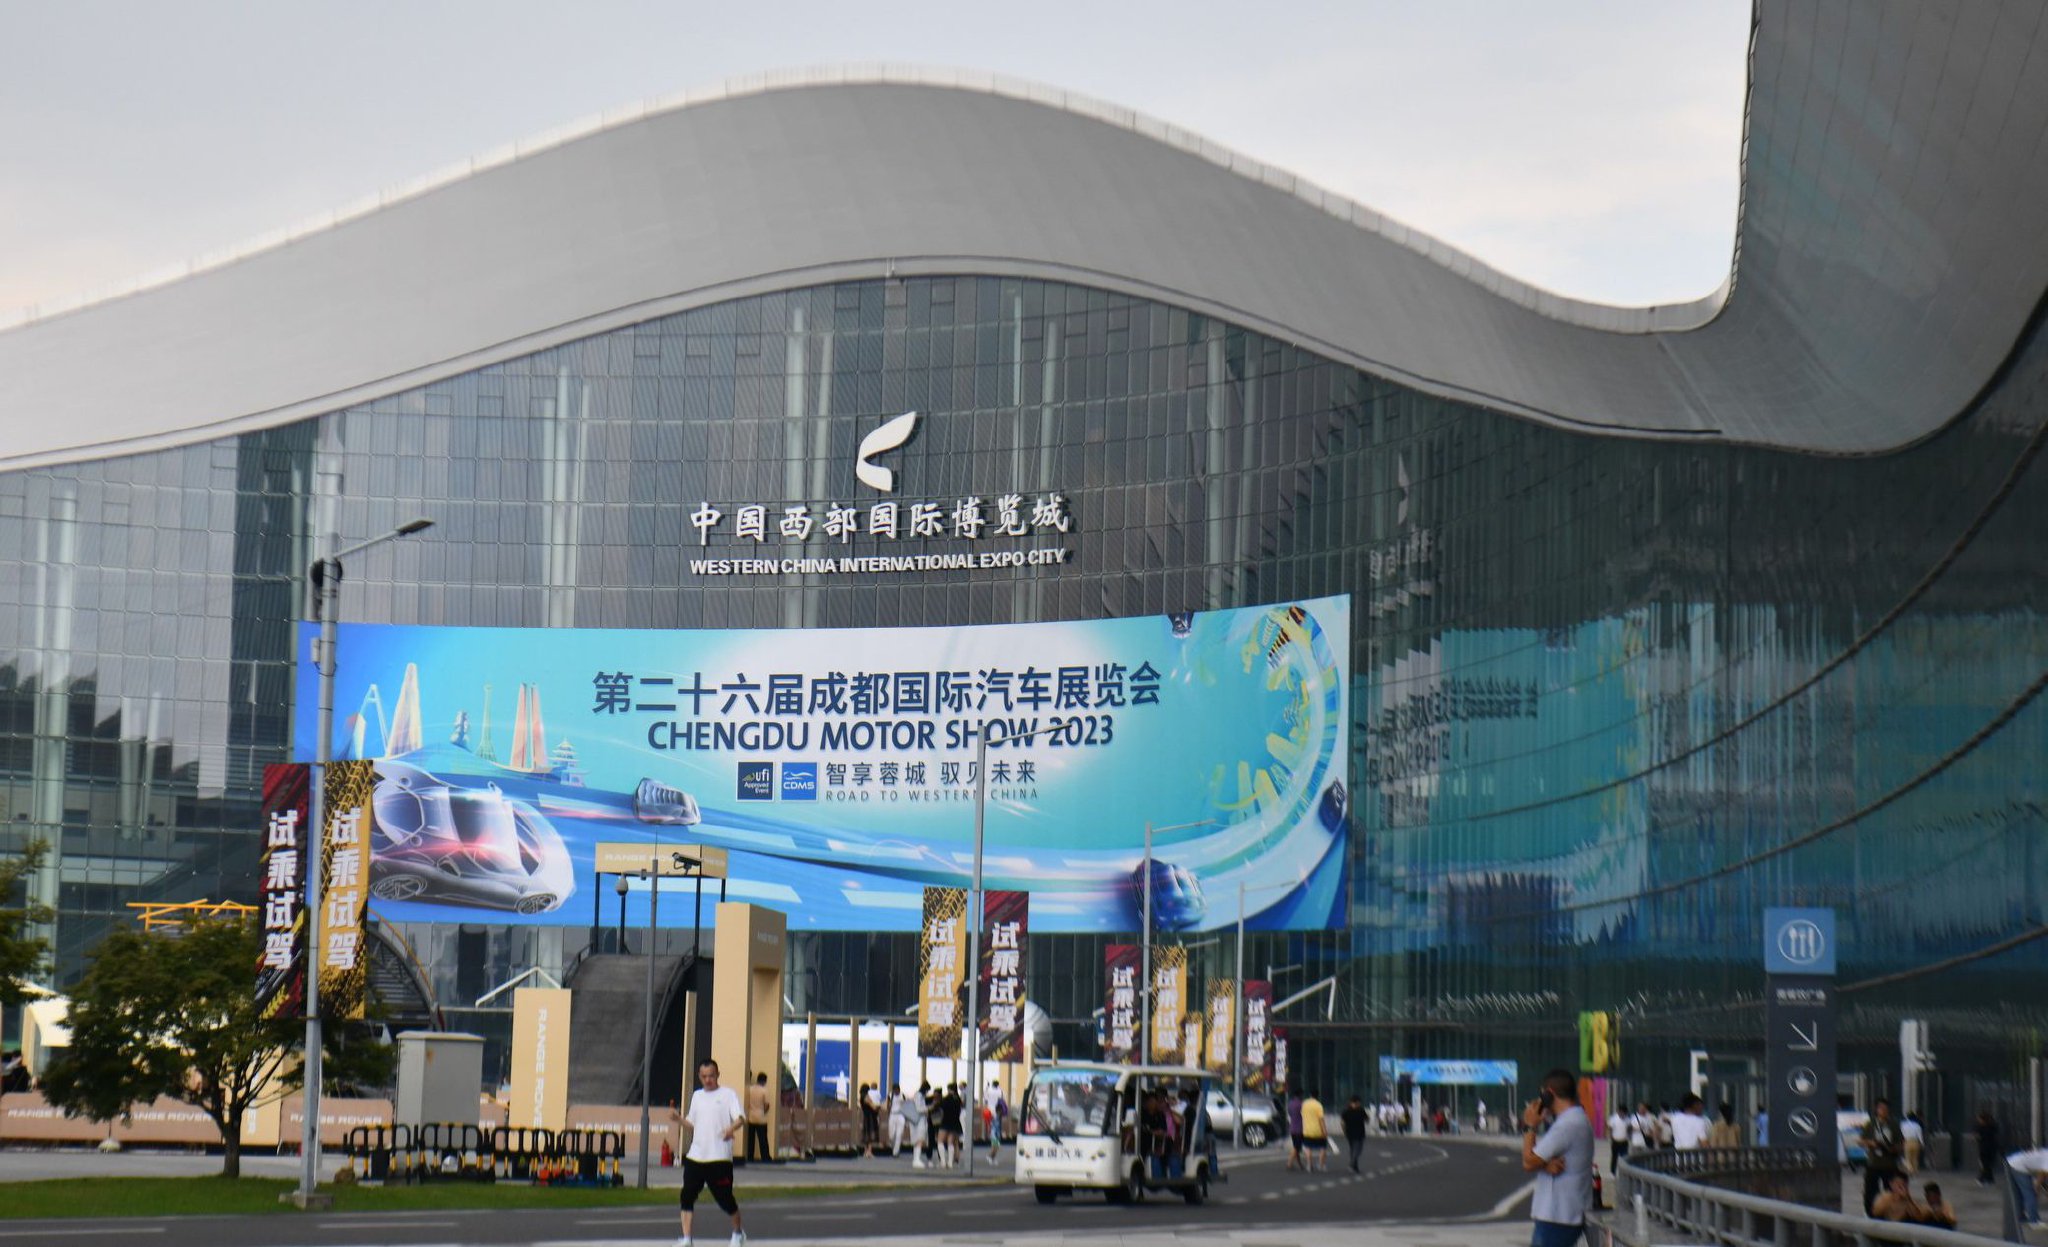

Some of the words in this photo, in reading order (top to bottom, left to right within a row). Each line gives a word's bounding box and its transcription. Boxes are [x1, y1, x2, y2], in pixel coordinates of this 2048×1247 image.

[690, 492, 1069, 545] 中国西部国际博览城
[690, 558, 778, 575] WESTERN
[781, 559, 836, 574] CHINA
[840, 552, 977, 573] INTERNATIONAL
[980, 551, 1025, 569] EXPO
[1028, 548, 1066, 564] CITY
[592, 660, 1162, 716] 第二十六届成都国际汽车展览会
[647, 721, 809, 751] CHENGDU
[819, 718, 935, 750] MOTOR
[945, 717, 1038, 750] SHOW
[1048, 714, 1114, 746] 2023
[783, 782, 815, 790] CDMS
[826, 761, 926, 786] 智享蓉城
[826, 790, 869, 801] ROAD
[881, 790, 898, 801] TO
[908, 790, 977, 800] WESTER
[990, 788, 1038, 800] CHINA
[264, 809, 298, 970] 试乘试驾
[326, 807, 361, 969] 试乘试驾
[927, 918, 957, 1026] 试乘试驾
[988, 921, 1020, 1031] 试乘试驾
